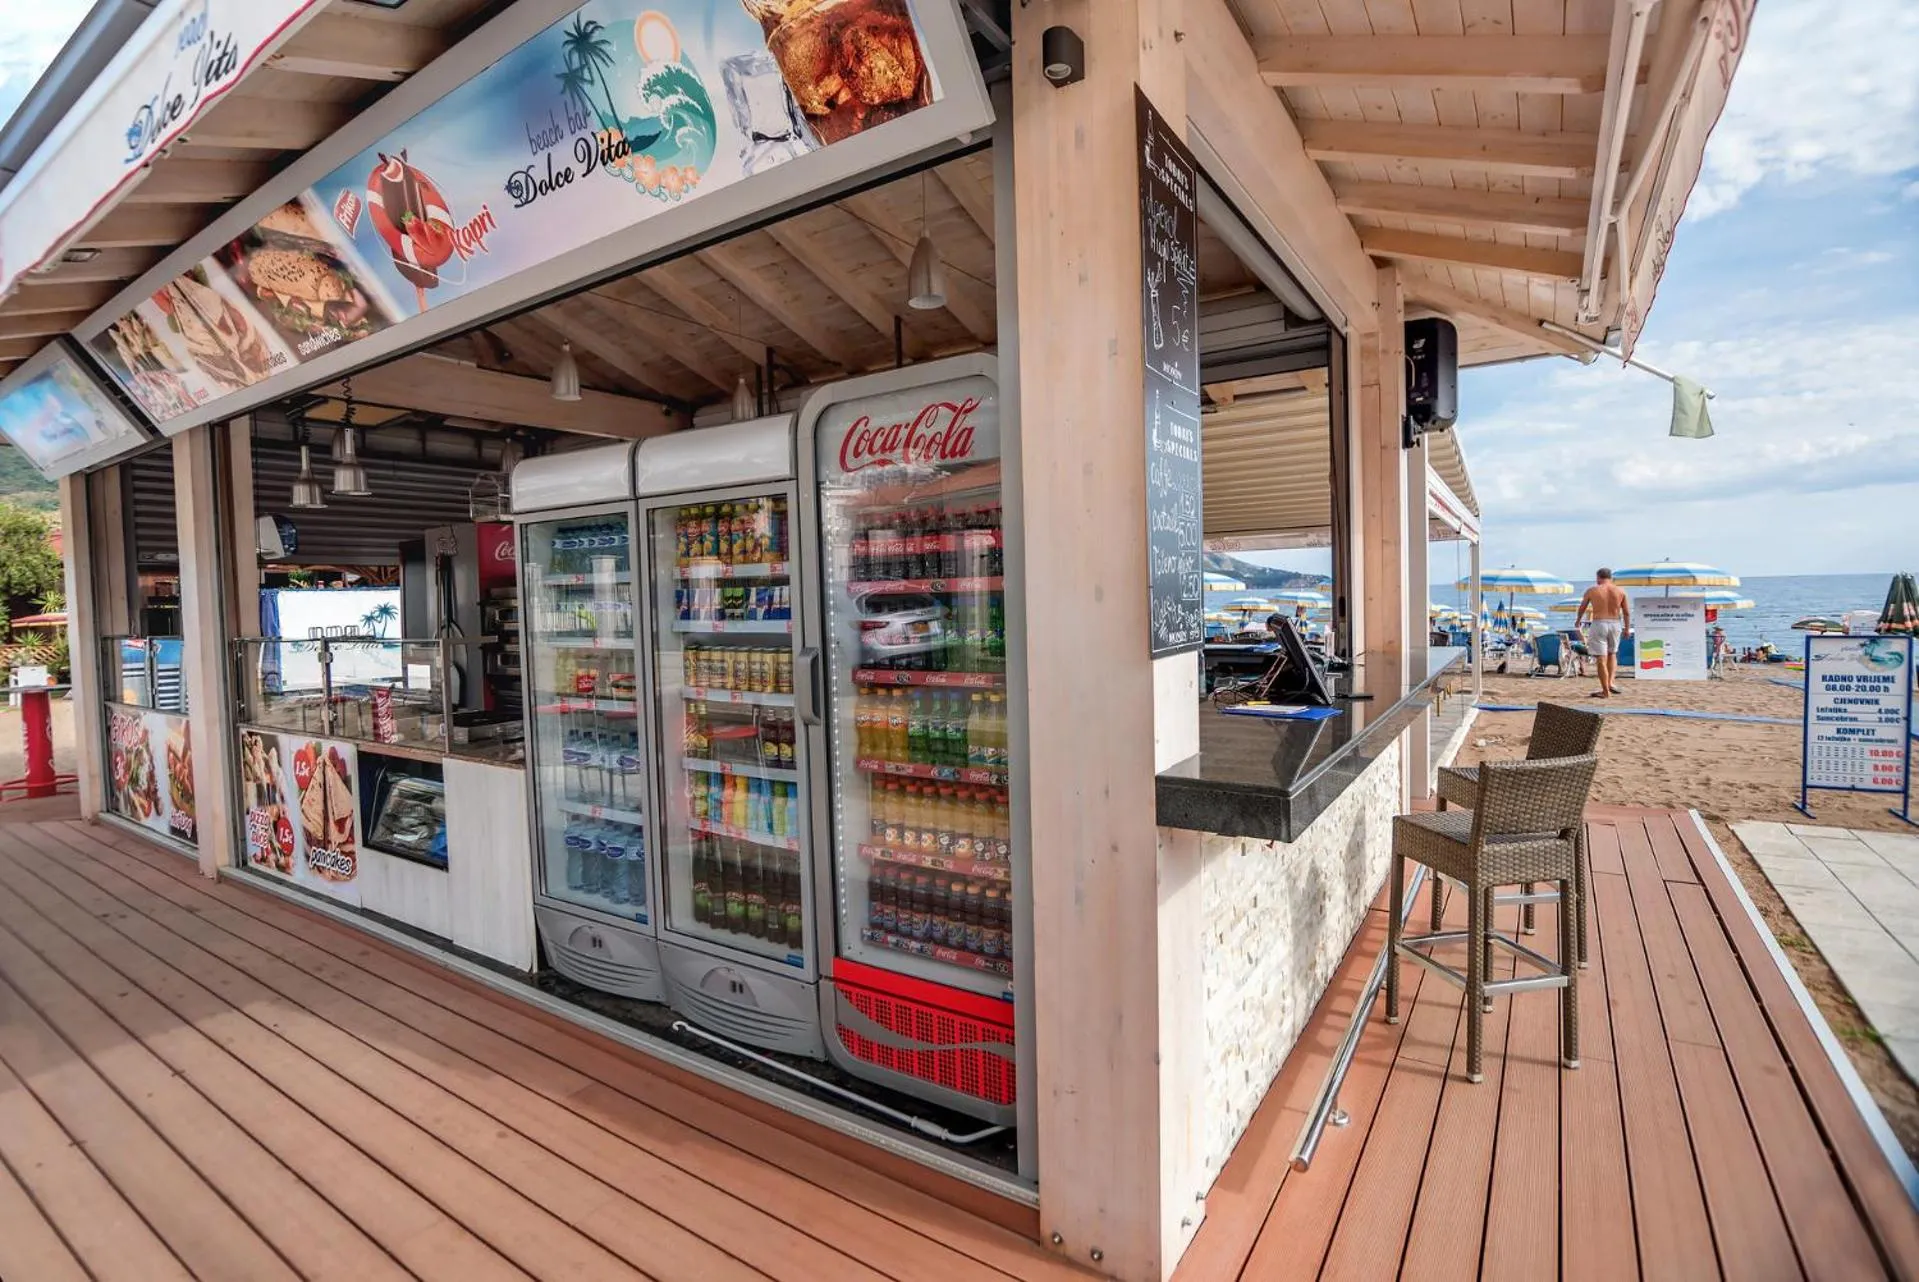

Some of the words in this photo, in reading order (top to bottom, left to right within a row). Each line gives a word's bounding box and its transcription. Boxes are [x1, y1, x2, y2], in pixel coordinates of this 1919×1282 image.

[189, 31, 238, 110] Vita
[527, 117, 564, 155] beach
[567, 103, 592, 136] bar
[505, 153, 575, 209] Dolce
[574, 131, 630, 178] Vita
[448, 203, 497, 261] Kapri
[1821, 674, 1854, 683] RADNO
[1855, 675, 1896, 684] VRIJEME
[1833, 697, 1881, 706] CJENOVNIK
[1836, 727, 1877, 737] KOMPLET
[310, 847, 353, 875] pancakes
